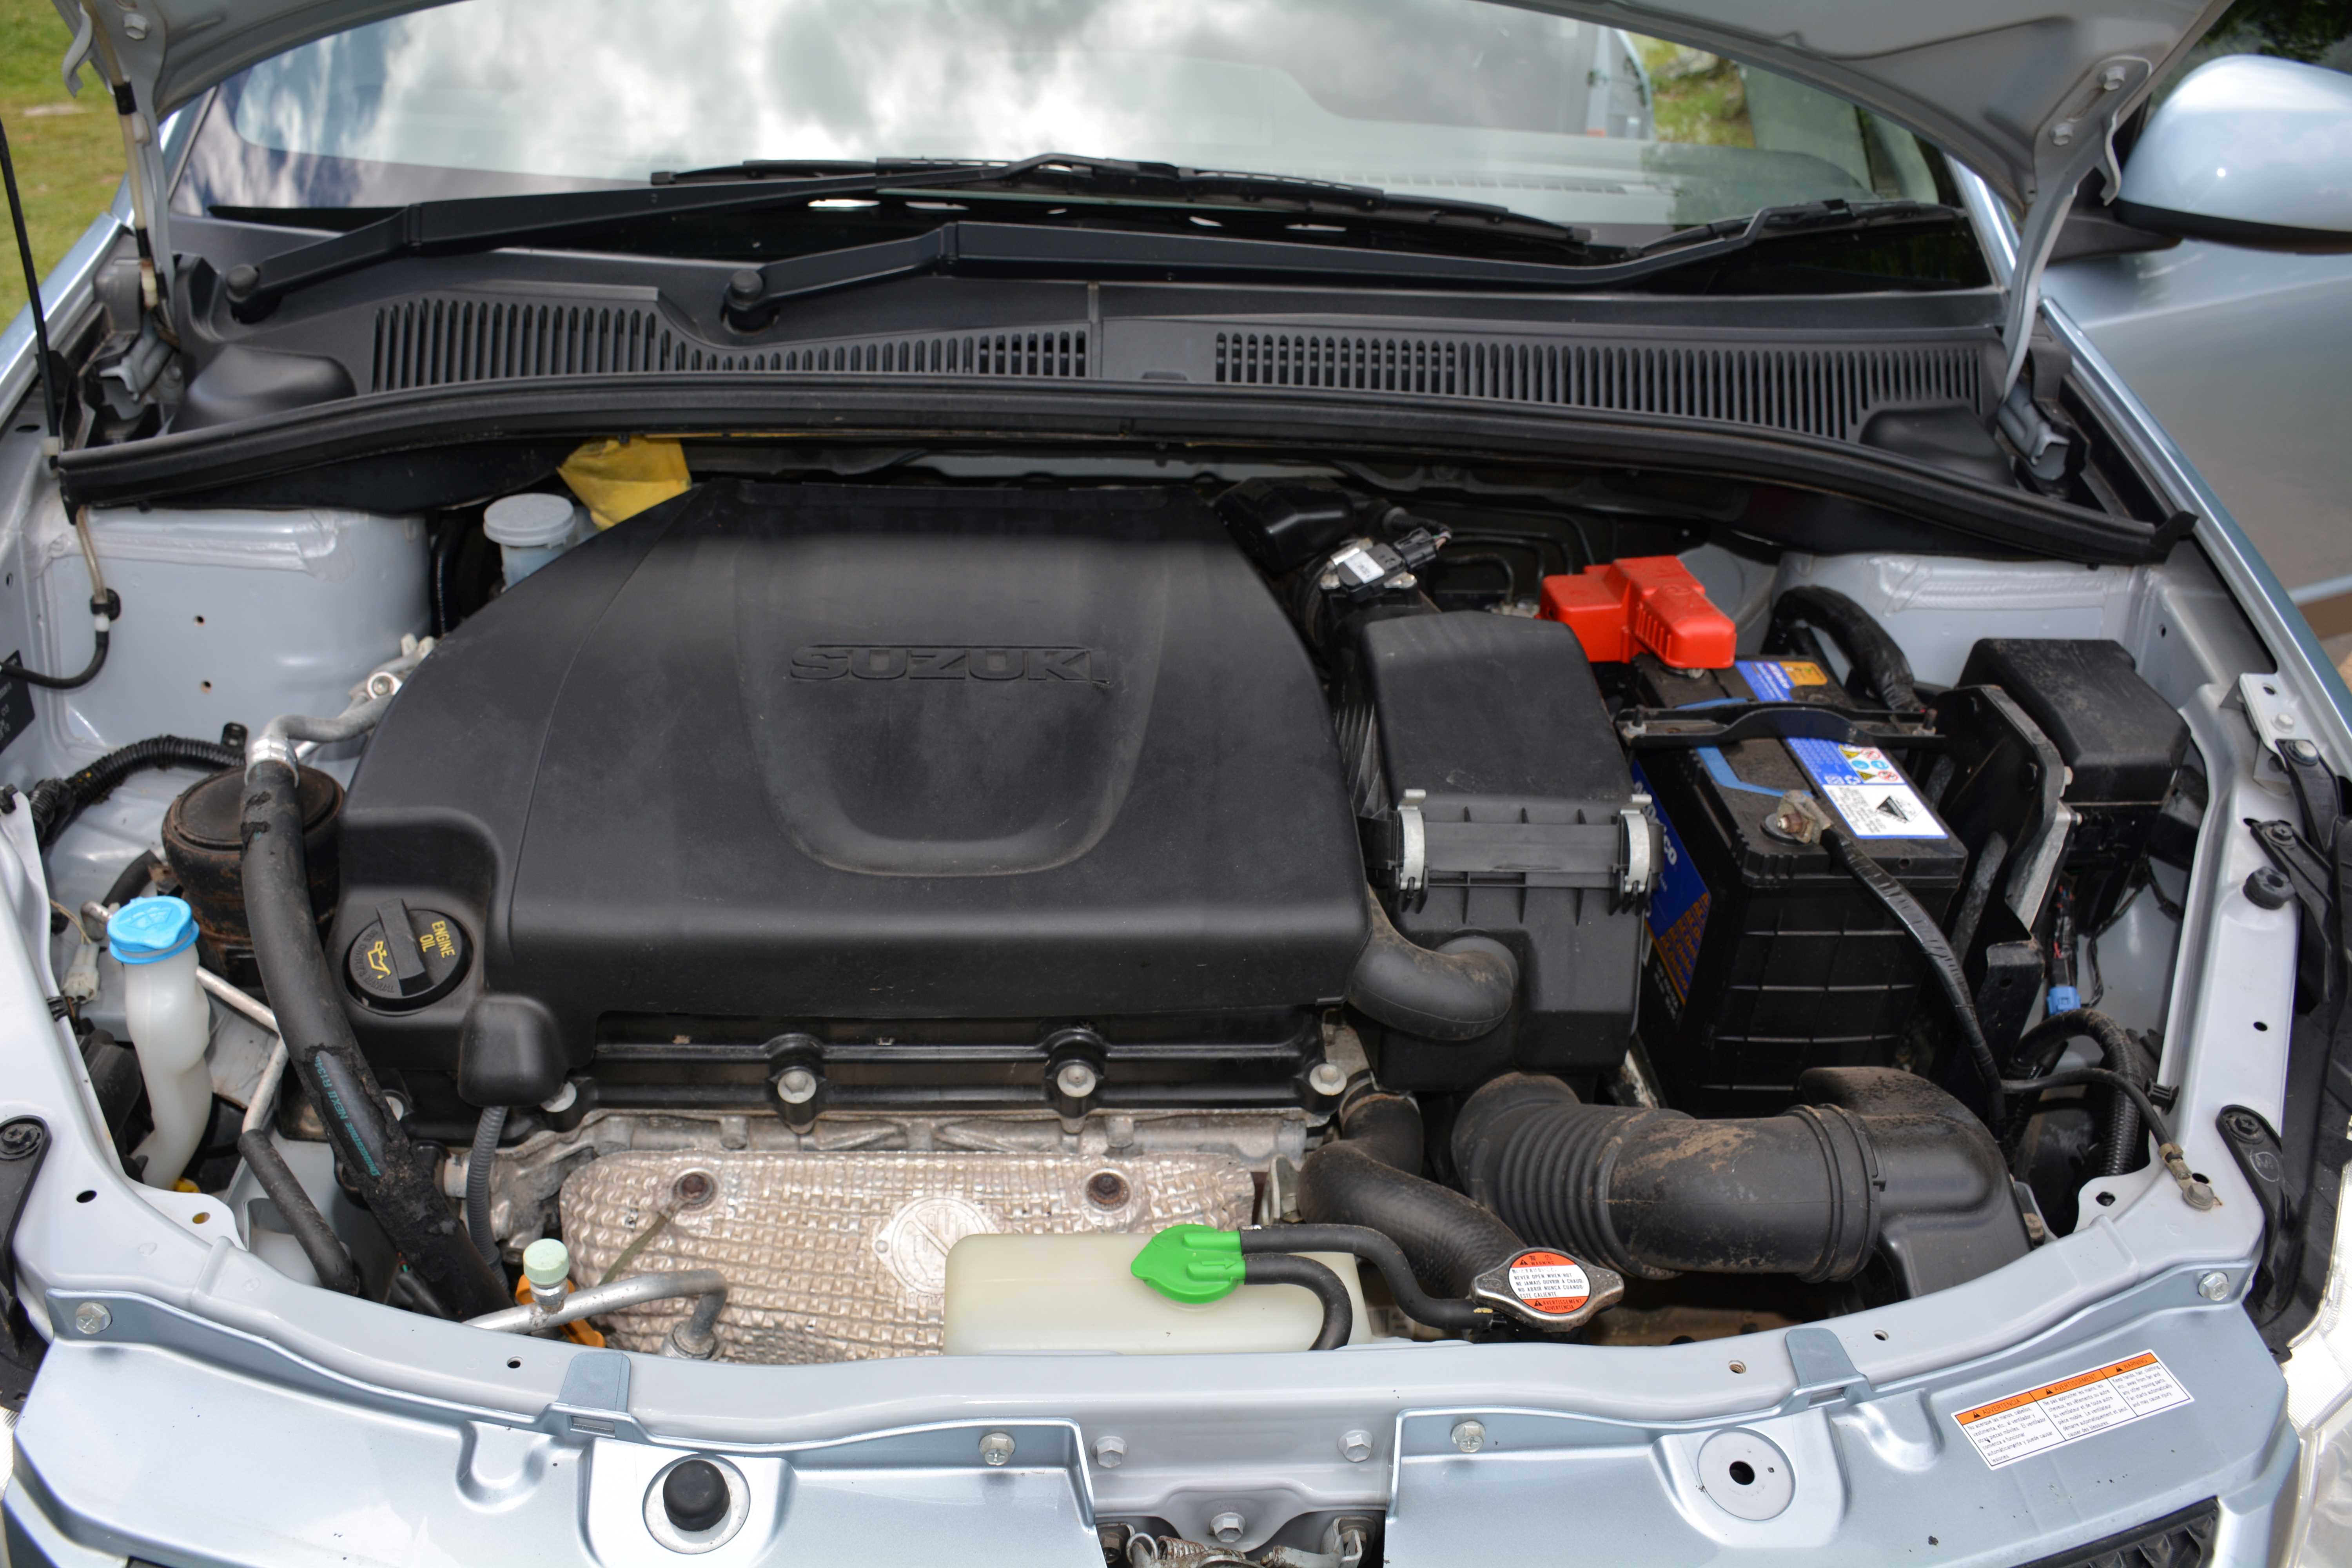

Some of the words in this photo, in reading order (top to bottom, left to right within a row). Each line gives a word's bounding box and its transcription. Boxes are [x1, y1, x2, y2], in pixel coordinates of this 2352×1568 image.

[790, 645, 1111, 684] SUZUKI
[420, 934, 435, 953] OIL
[431, 920, 456, 958] ENGINE
[345, 1122, 381, 1176] BRIDGESTONE
[2123, 1357, 2148, 1369] WARNING
[2054, 1374, 2098, 1392] AVERTISSEMENT
[2147, 1383, 2172, 1395] automatically
[2058, 1392, 2077, 1401] approcher
[1982, 1399, 2022, 1415] ADVERTENCIA
[2059, 1407, 2080, 1416] ventilateur
[2091, 1405, 2111, 1414] ventilateur
[1975, 1420, 1992, 1428] acerque
[2012, 1415, 2031, 1424] ventilador
[2027, 1418, 2045, 1427] ventilador
[2080, 1411, 2113, 1426] automatiquement
[1982, 1441, 2002, 1450] comienza
[2005, 1432, 2025, 1441] funcionar
